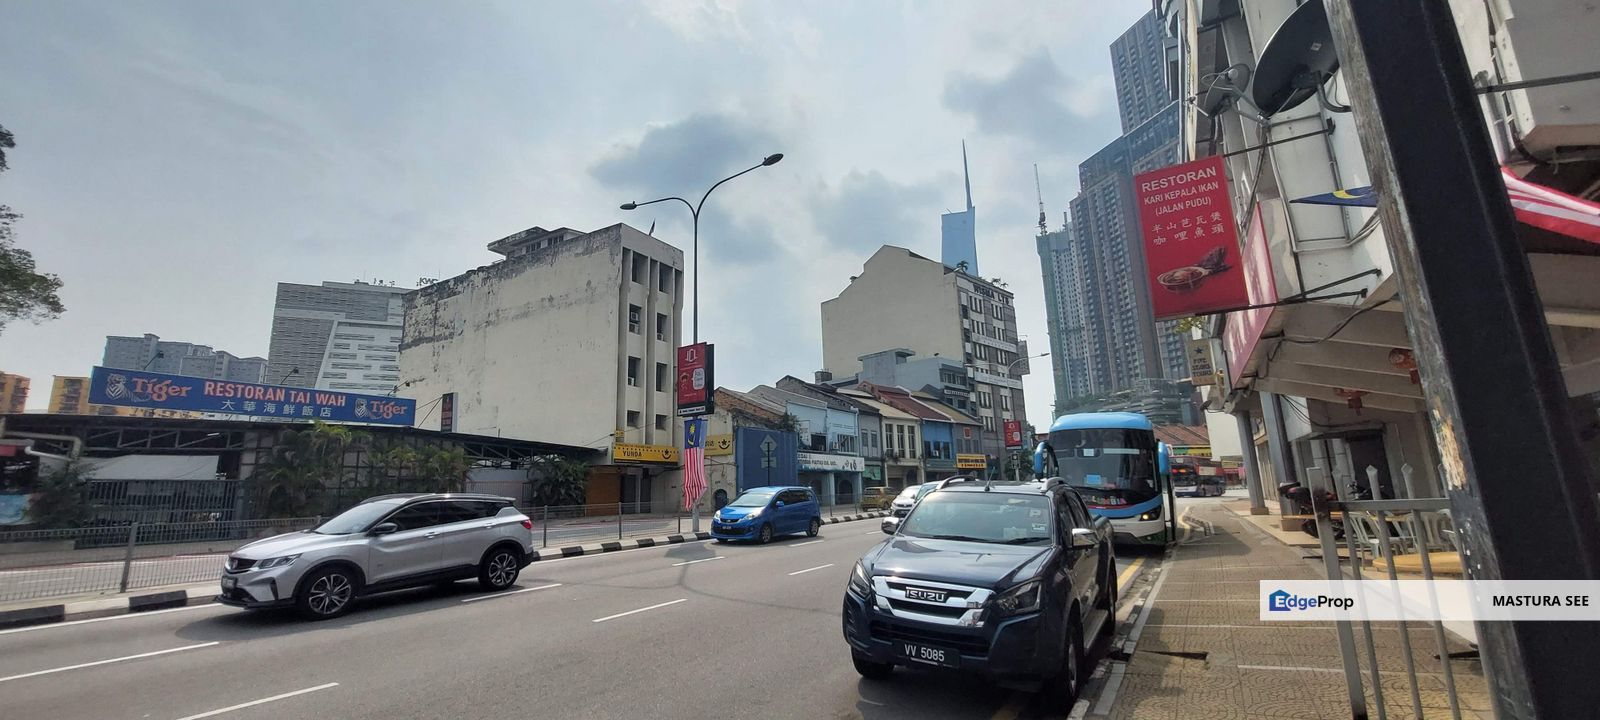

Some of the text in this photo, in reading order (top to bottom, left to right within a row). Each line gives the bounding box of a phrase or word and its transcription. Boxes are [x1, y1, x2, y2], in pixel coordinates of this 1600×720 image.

[1141, 166, 1217, 193] RESTORAN
[1143, 181, 1219, 206] KARI KEPALA IKAN
[1155, 196, 1212, 216] (JALAN PUDU)
[132, 377, 191, 401] Tiger
[204, 381, 347, 407] RESTORAN TAI WAH
[221, 399, 332, 418] 大華海鮮飯店
[370, 400, 408, 419] Tiger
[622, 450, 643, 458] YUNDA
[905, 589, 945, 601] ISUZU
[904, 643, 945, 662] VV 5085
